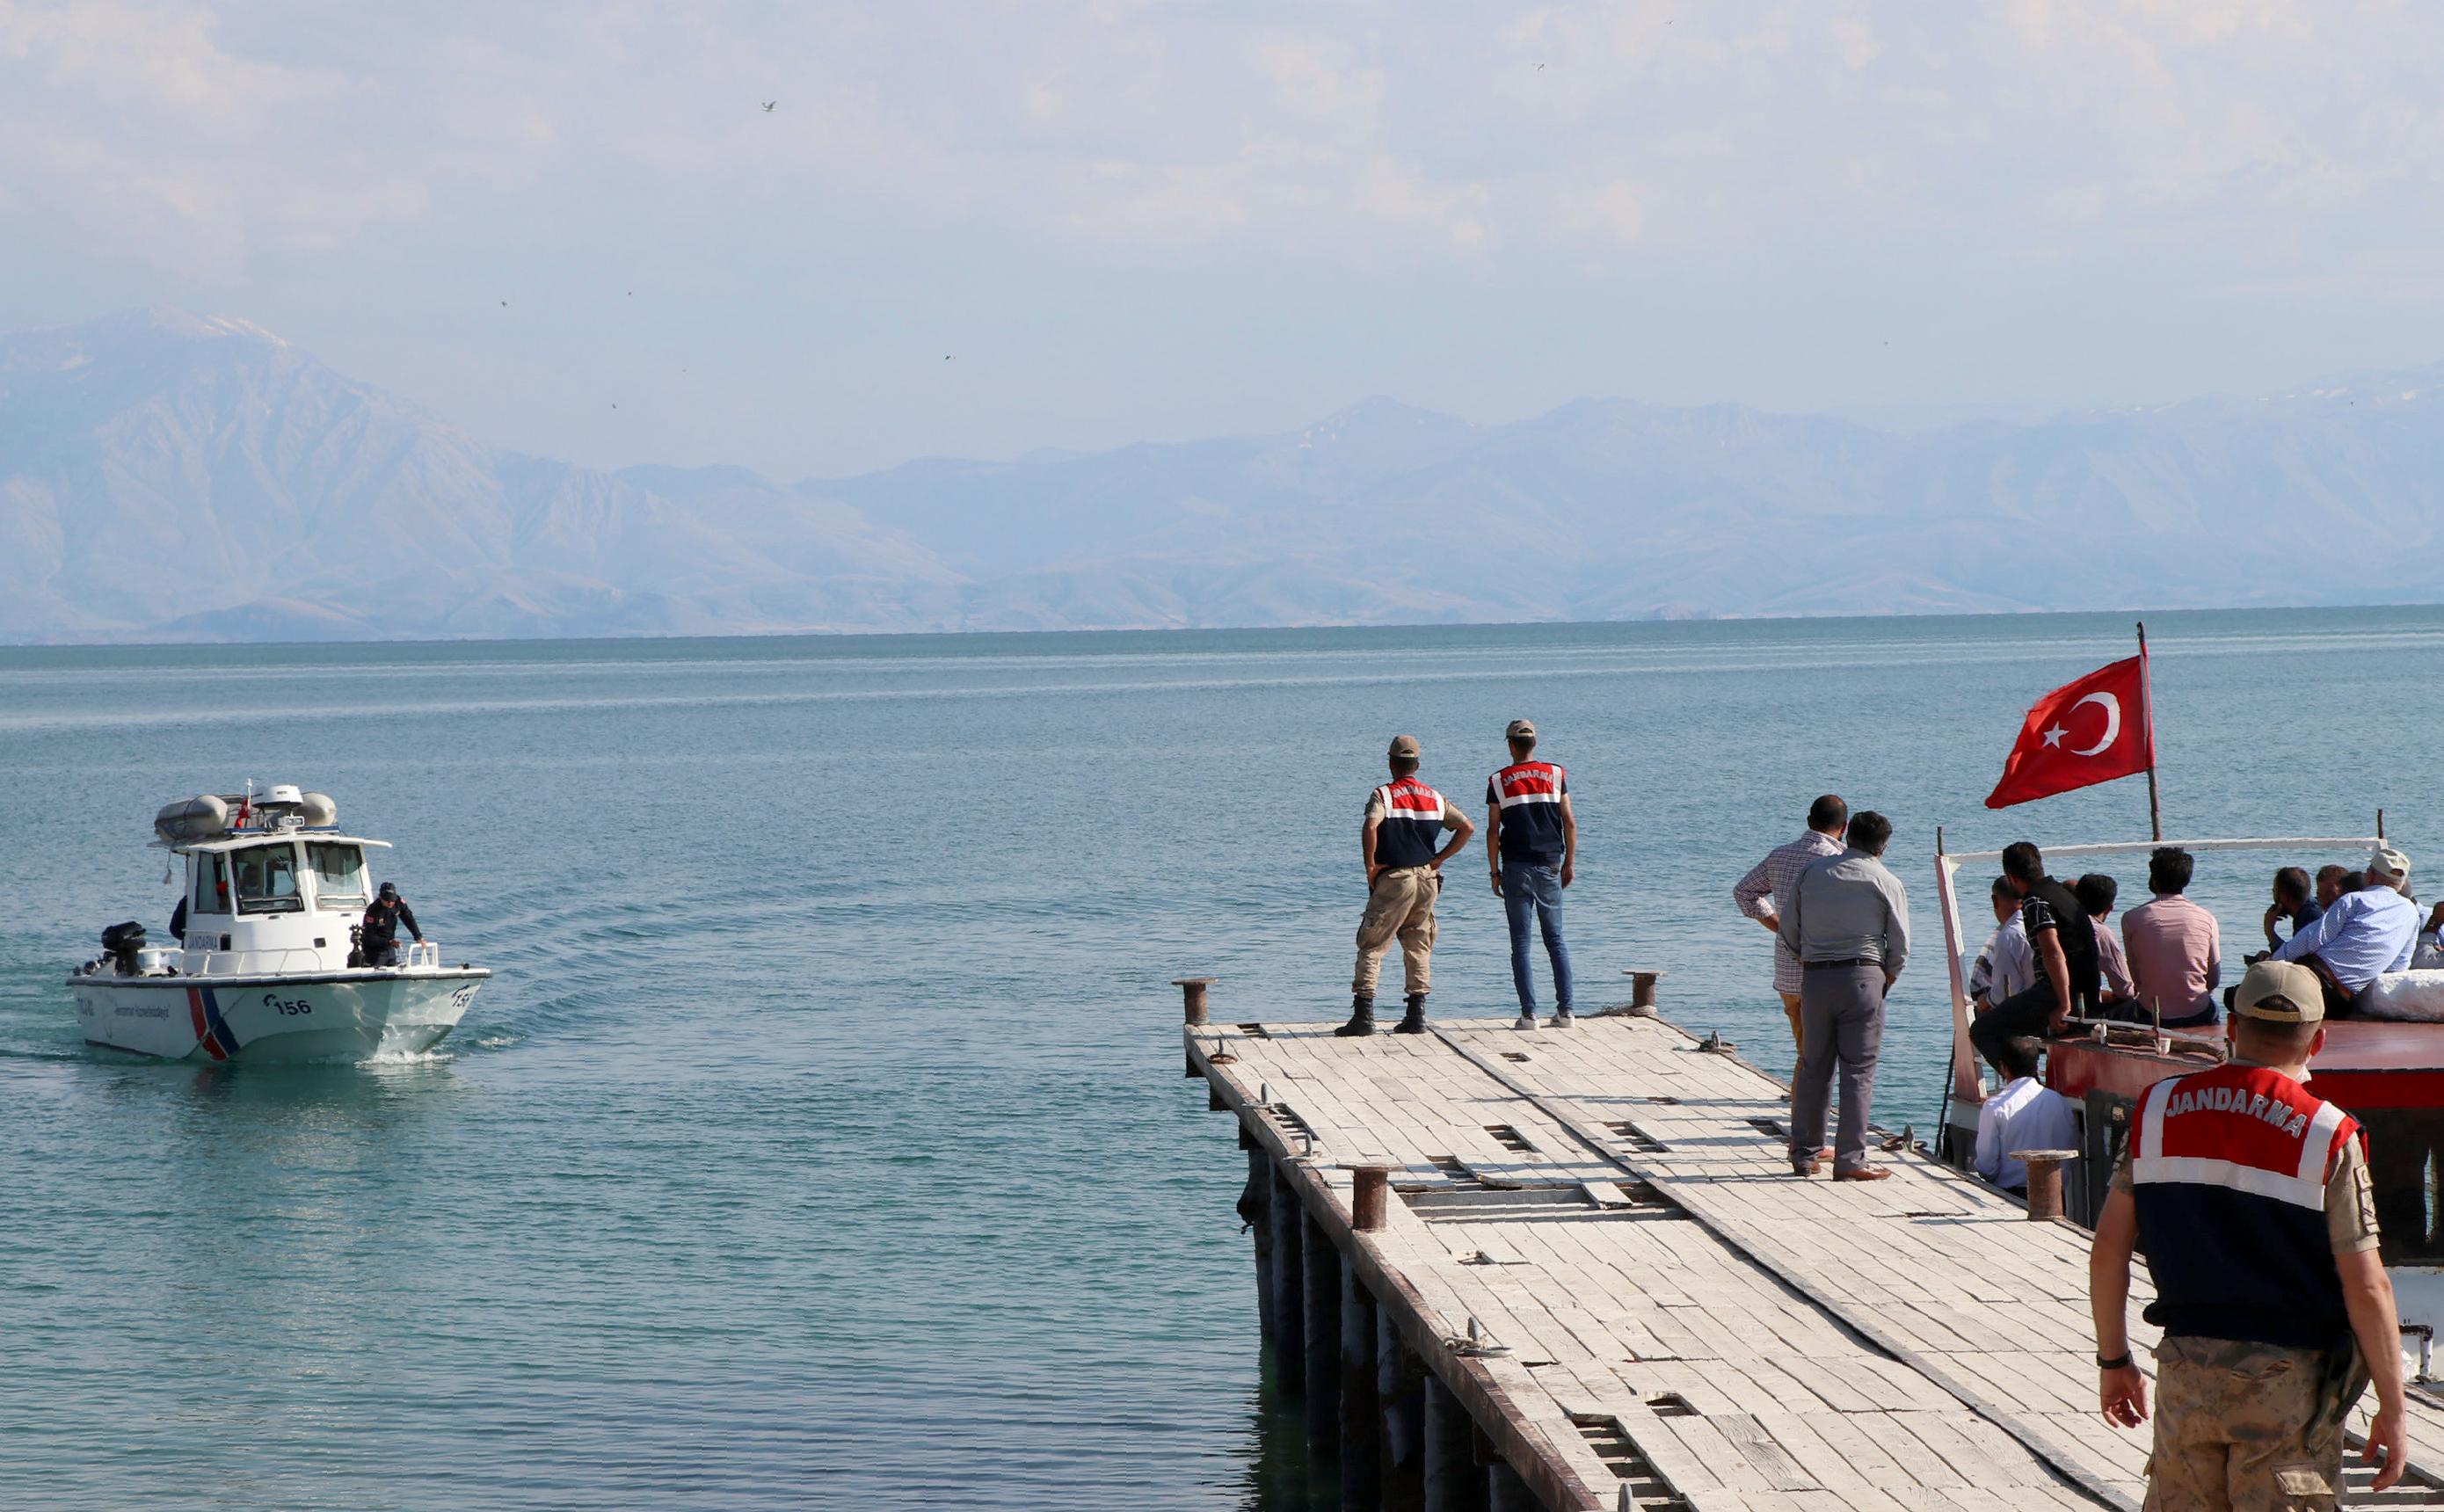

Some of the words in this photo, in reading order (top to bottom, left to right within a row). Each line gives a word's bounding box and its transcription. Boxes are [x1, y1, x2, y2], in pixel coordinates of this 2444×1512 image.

[1503, 769, 1554, 787] JANDARMA
[273, 1000, 311, 1015] 156
[2165, 1087, 2308, 1139] JANDARMA
